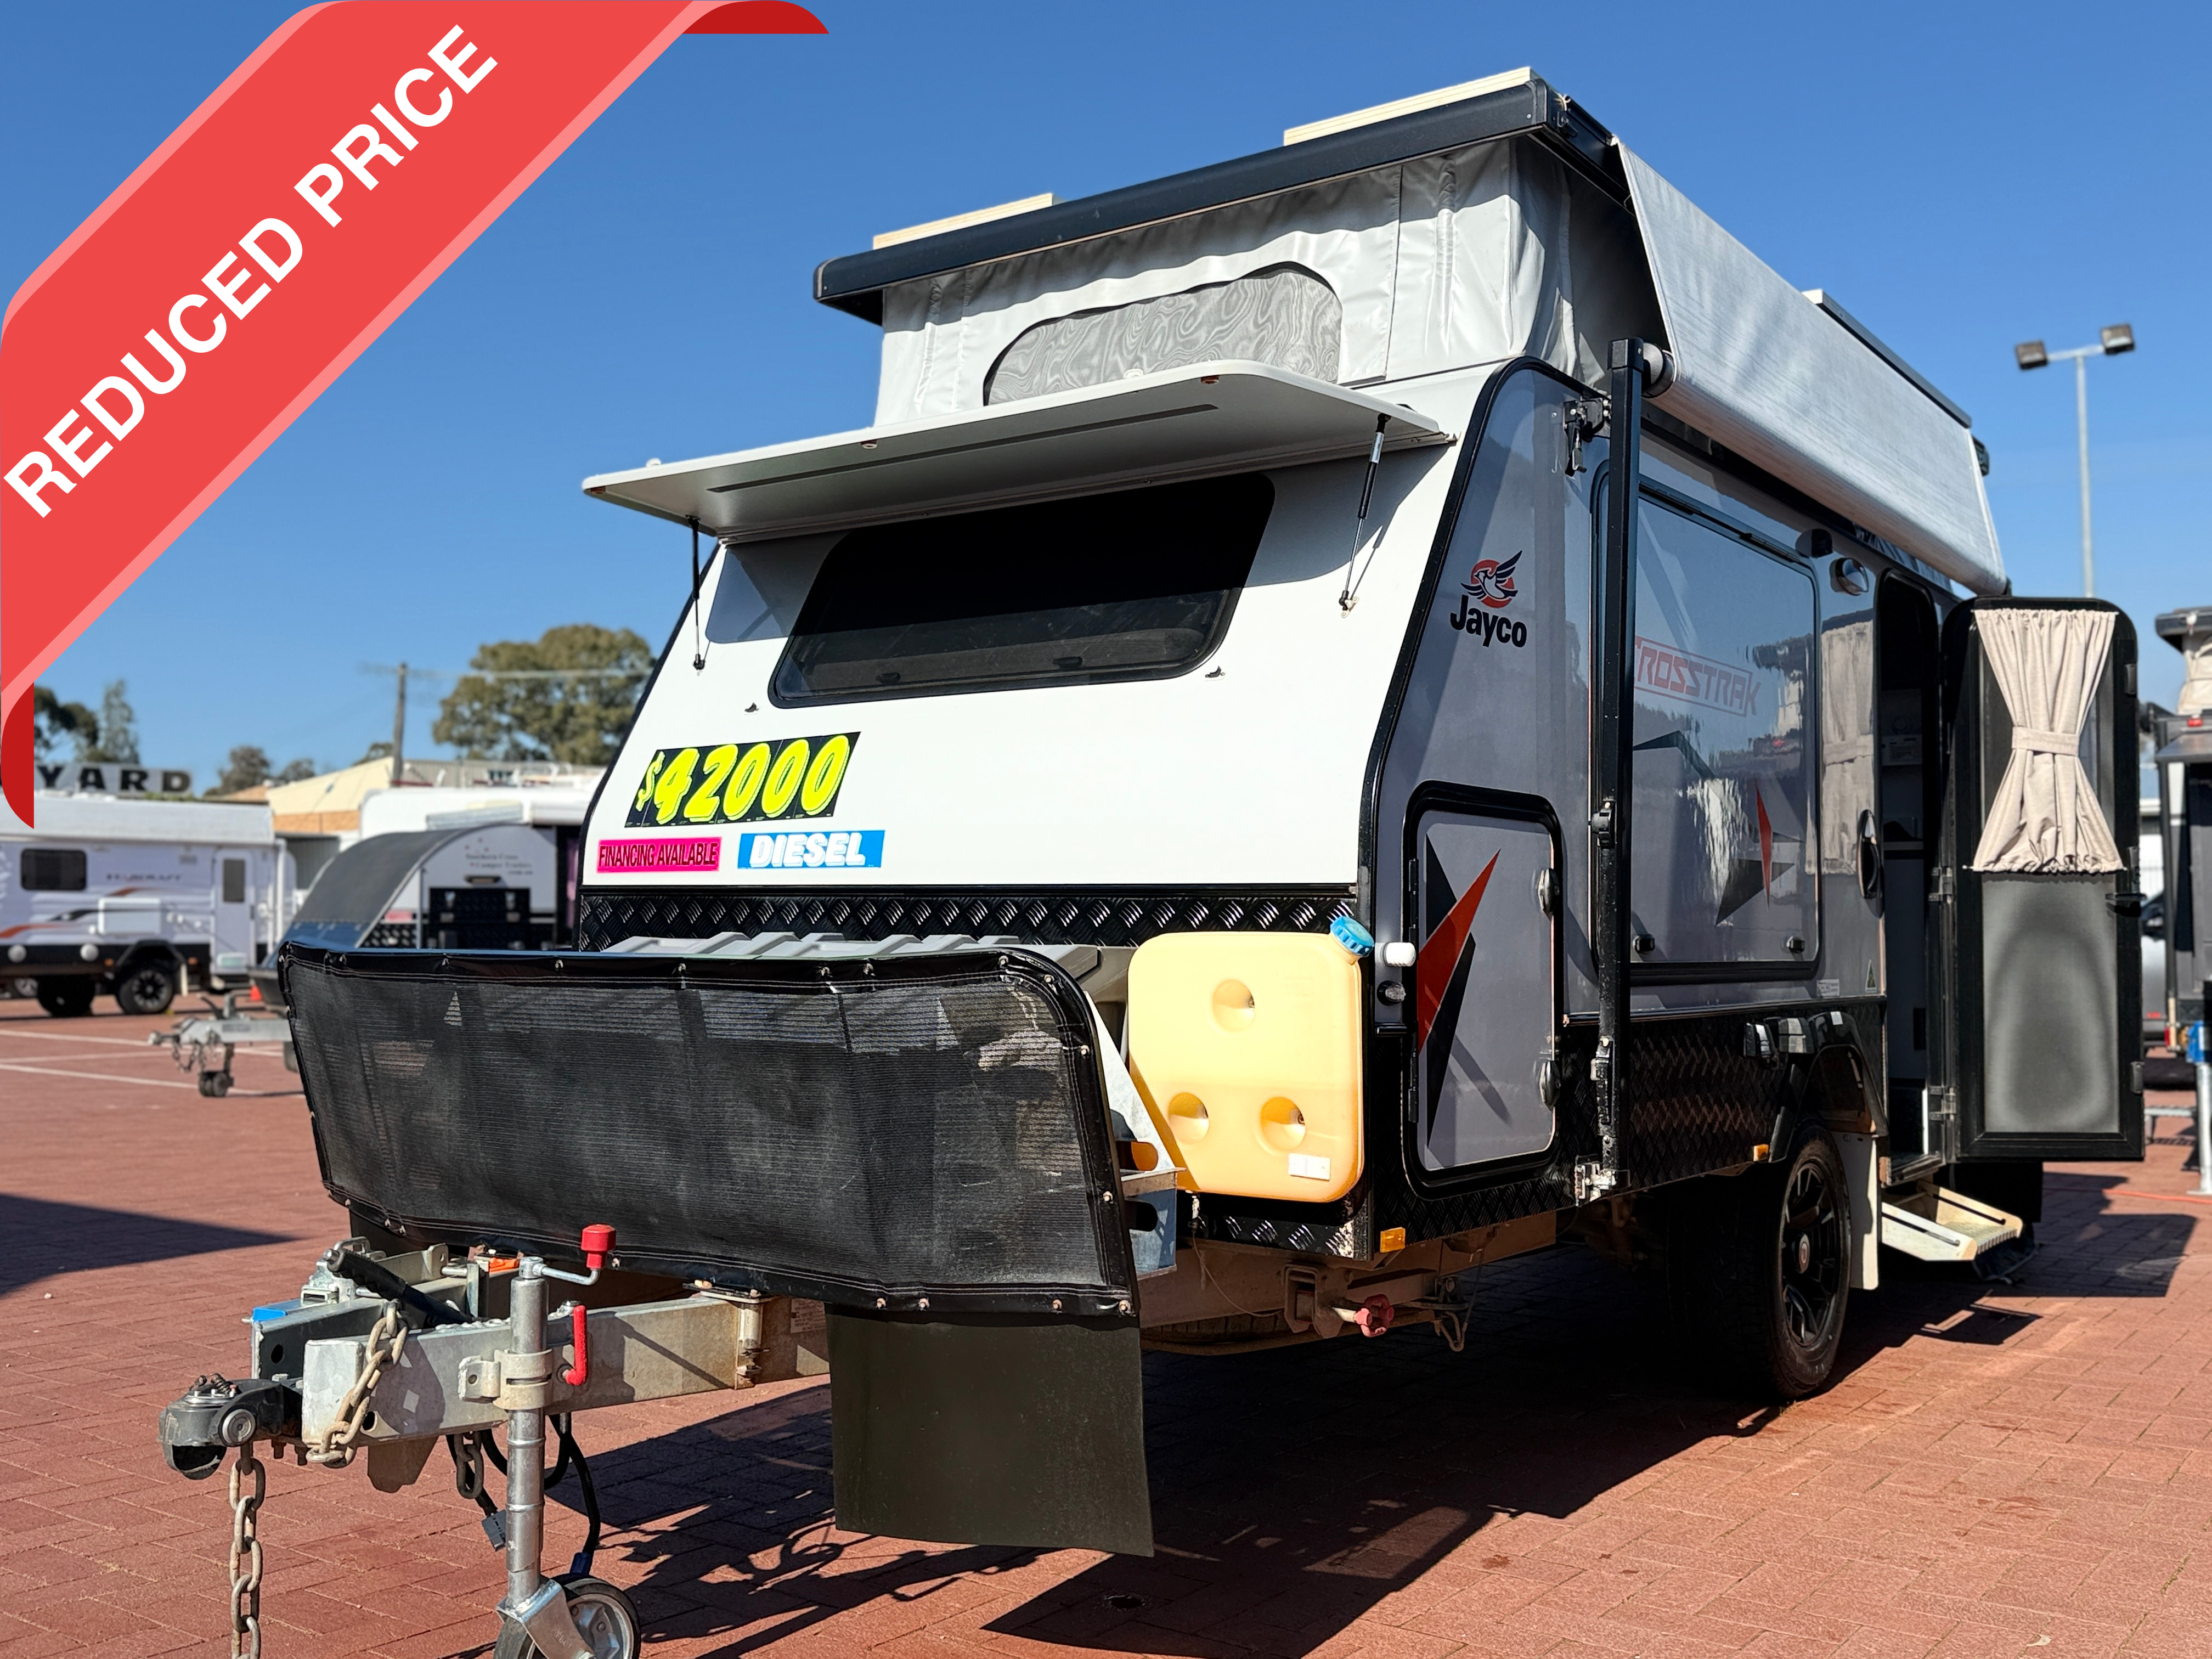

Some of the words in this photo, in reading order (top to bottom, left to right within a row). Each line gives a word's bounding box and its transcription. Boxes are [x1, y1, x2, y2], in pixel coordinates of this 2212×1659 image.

[1450, 594, 1527, 647] Jayco
[37, 766, 190, 792] YARD
[636, 735, 850, 825] $42000
[599, 845, 655, 868] FINANCING
[658, 843, 717, 866] AVAILABLE
[749, 833, 866, 867] DIESEL
